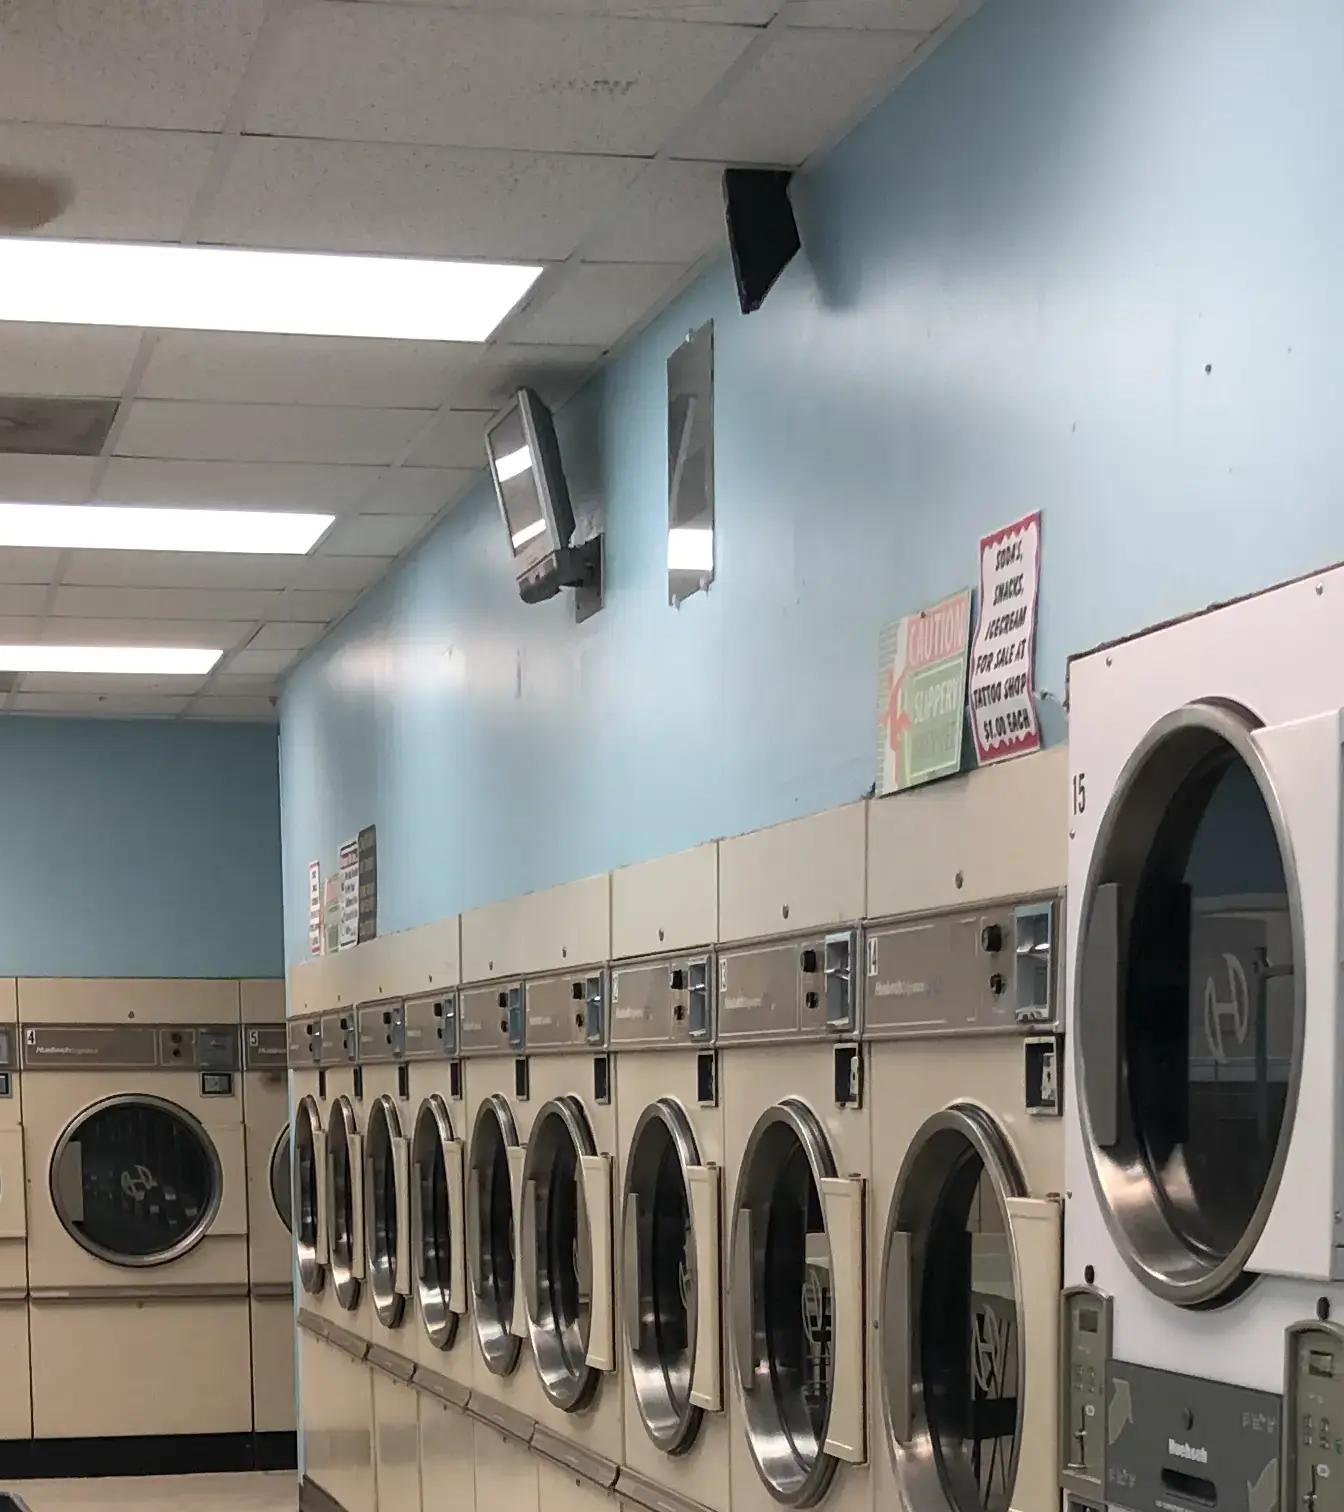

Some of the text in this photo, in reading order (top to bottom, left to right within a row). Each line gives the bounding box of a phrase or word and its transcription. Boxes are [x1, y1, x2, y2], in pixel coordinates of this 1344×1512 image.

[908, 602, 966, 666] CAUTION
[975, 638, 1027, 676] FOR SALE AT
[914, 675, 960, 725] SLIPPERY
[973, 672, 1027, 710] TATTOO SHOP
[983, 716, 1007, 742] $1.00
[1006, 708, 1031, 733] EACH
[1072, 772, 1086, 815] 15
[28, 1030, 34, 1044] 4
[1168, 1438, 1208, 1464] Huebsch
